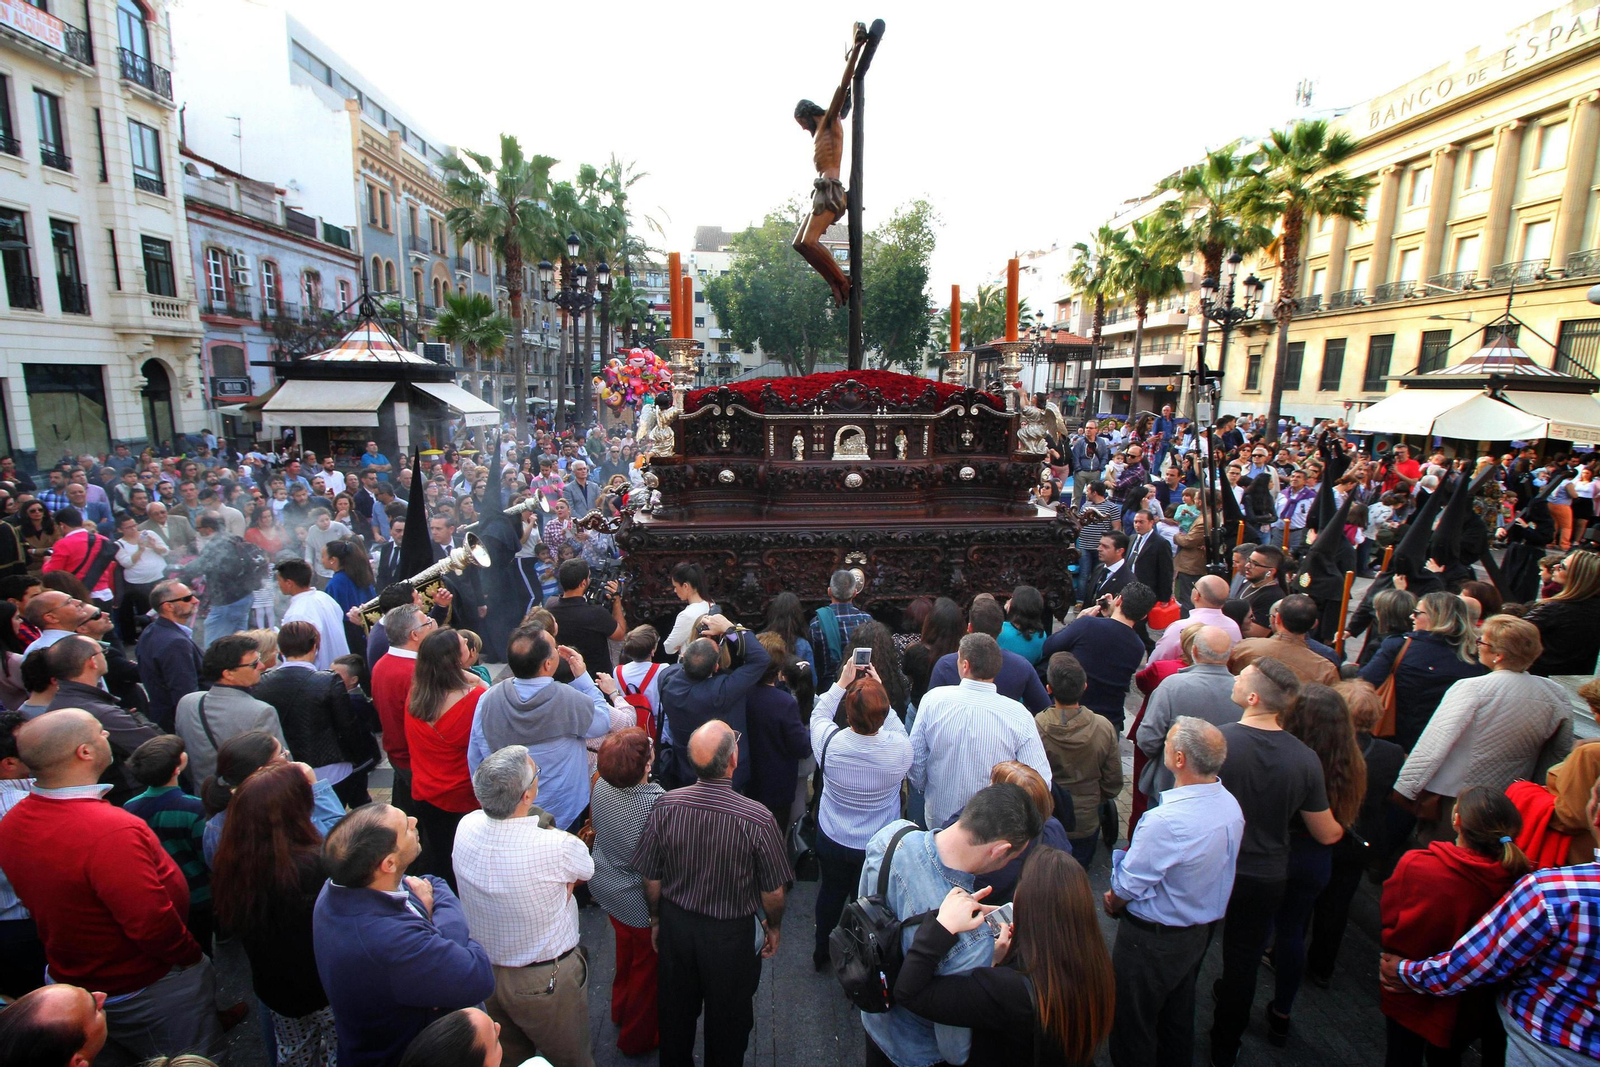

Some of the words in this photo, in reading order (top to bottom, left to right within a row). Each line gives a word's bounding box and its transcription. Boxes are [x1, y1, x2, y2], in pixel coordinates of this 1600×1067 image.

[13, 10, 62, 49] ALQUILER
[1368, 77, 1454, 131] BANCO
[1466, 66, 1490, 87] DE
